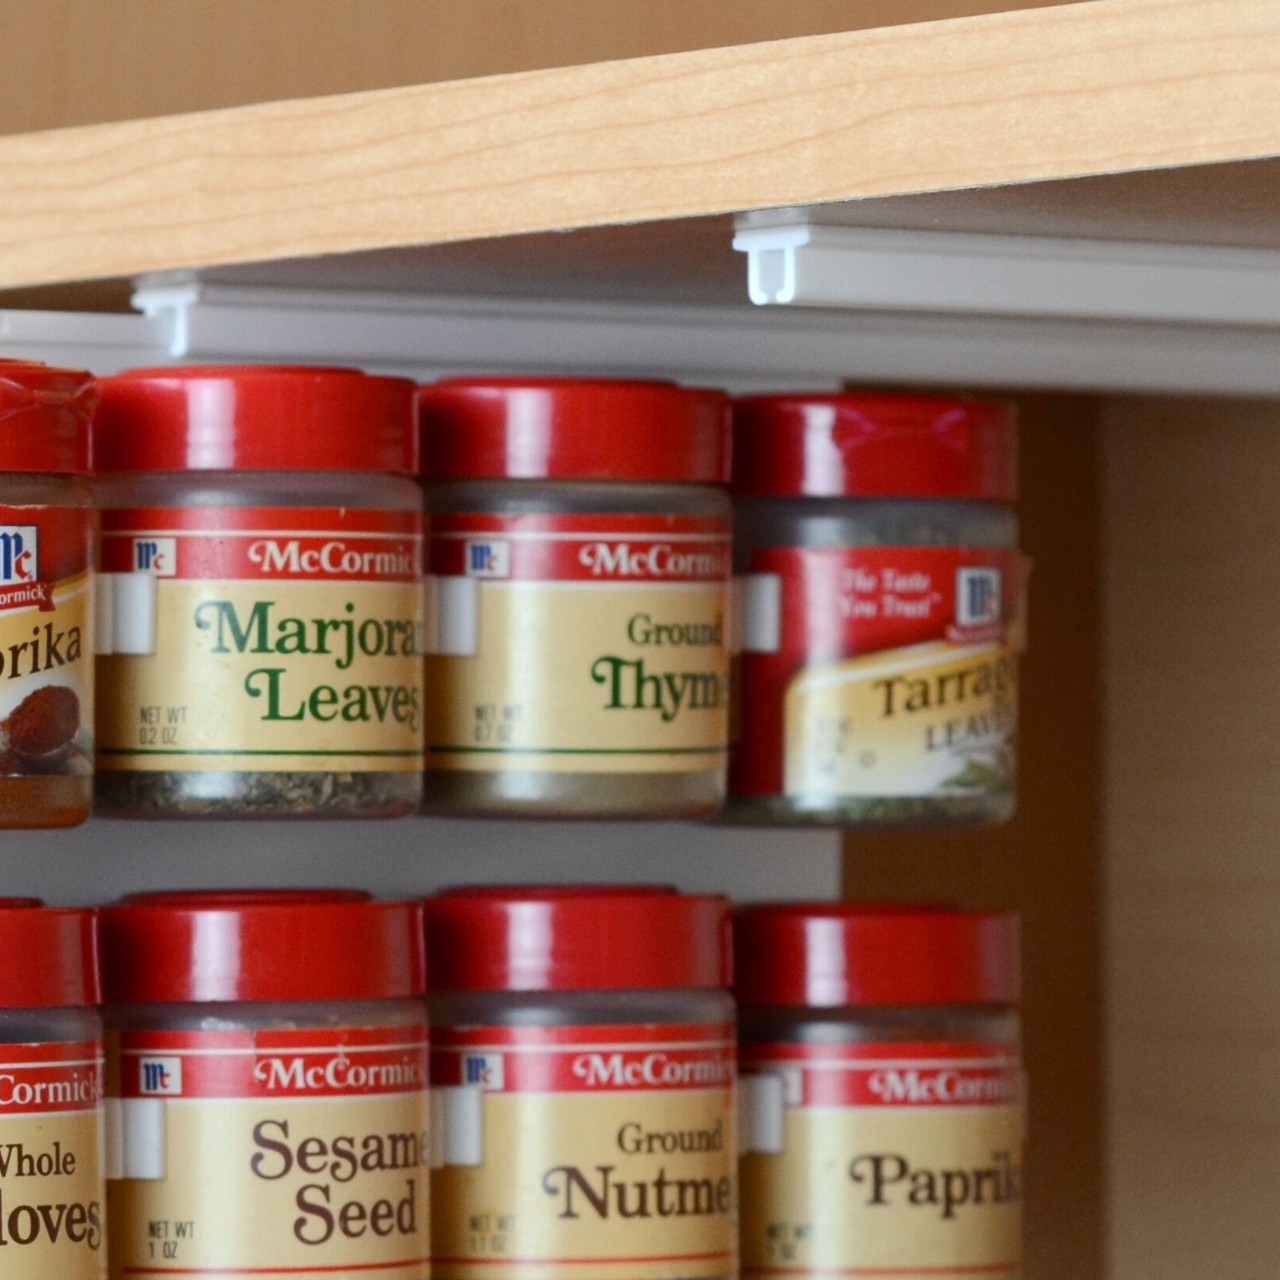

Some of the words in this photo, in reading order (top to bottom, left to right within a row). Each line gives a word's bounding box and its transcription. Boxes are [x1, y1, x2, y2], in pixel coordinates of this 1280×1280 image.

[140, 706, 161, 724] NET
[167, 706, 188, 724] WT
[162, 727, 178, 745] OZ
[250, 1118, 426, 1184] Sesam
[293, 1179, 417, 1246] Seed
[148, 1221, 169, 1239] NET
[175, 1221, 195, 1239] WT
[163, 1241, 178, 1259] OZ
